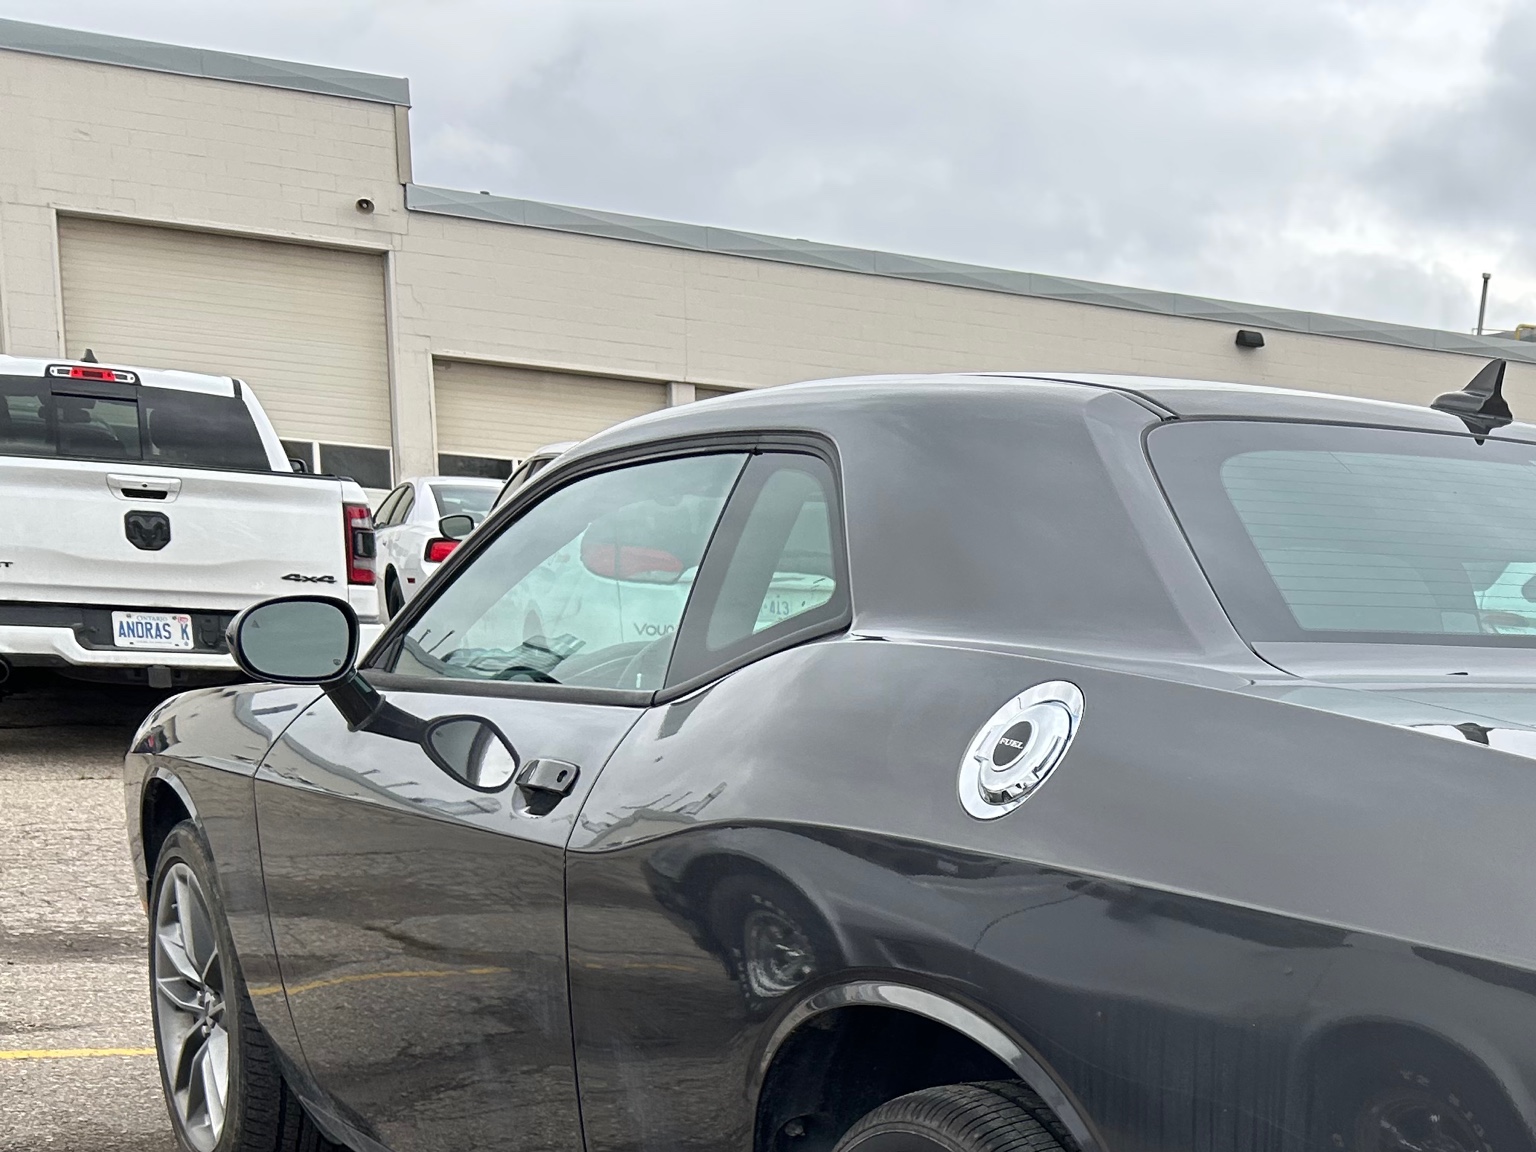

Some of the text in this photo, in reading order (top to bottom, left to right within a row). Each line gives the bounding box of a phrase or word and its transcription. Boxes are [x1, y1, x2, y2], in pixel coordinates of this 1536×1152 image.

[118, 620, 190, 640] ANDRAS K
[999, 737, 1024, 749] FUEL
